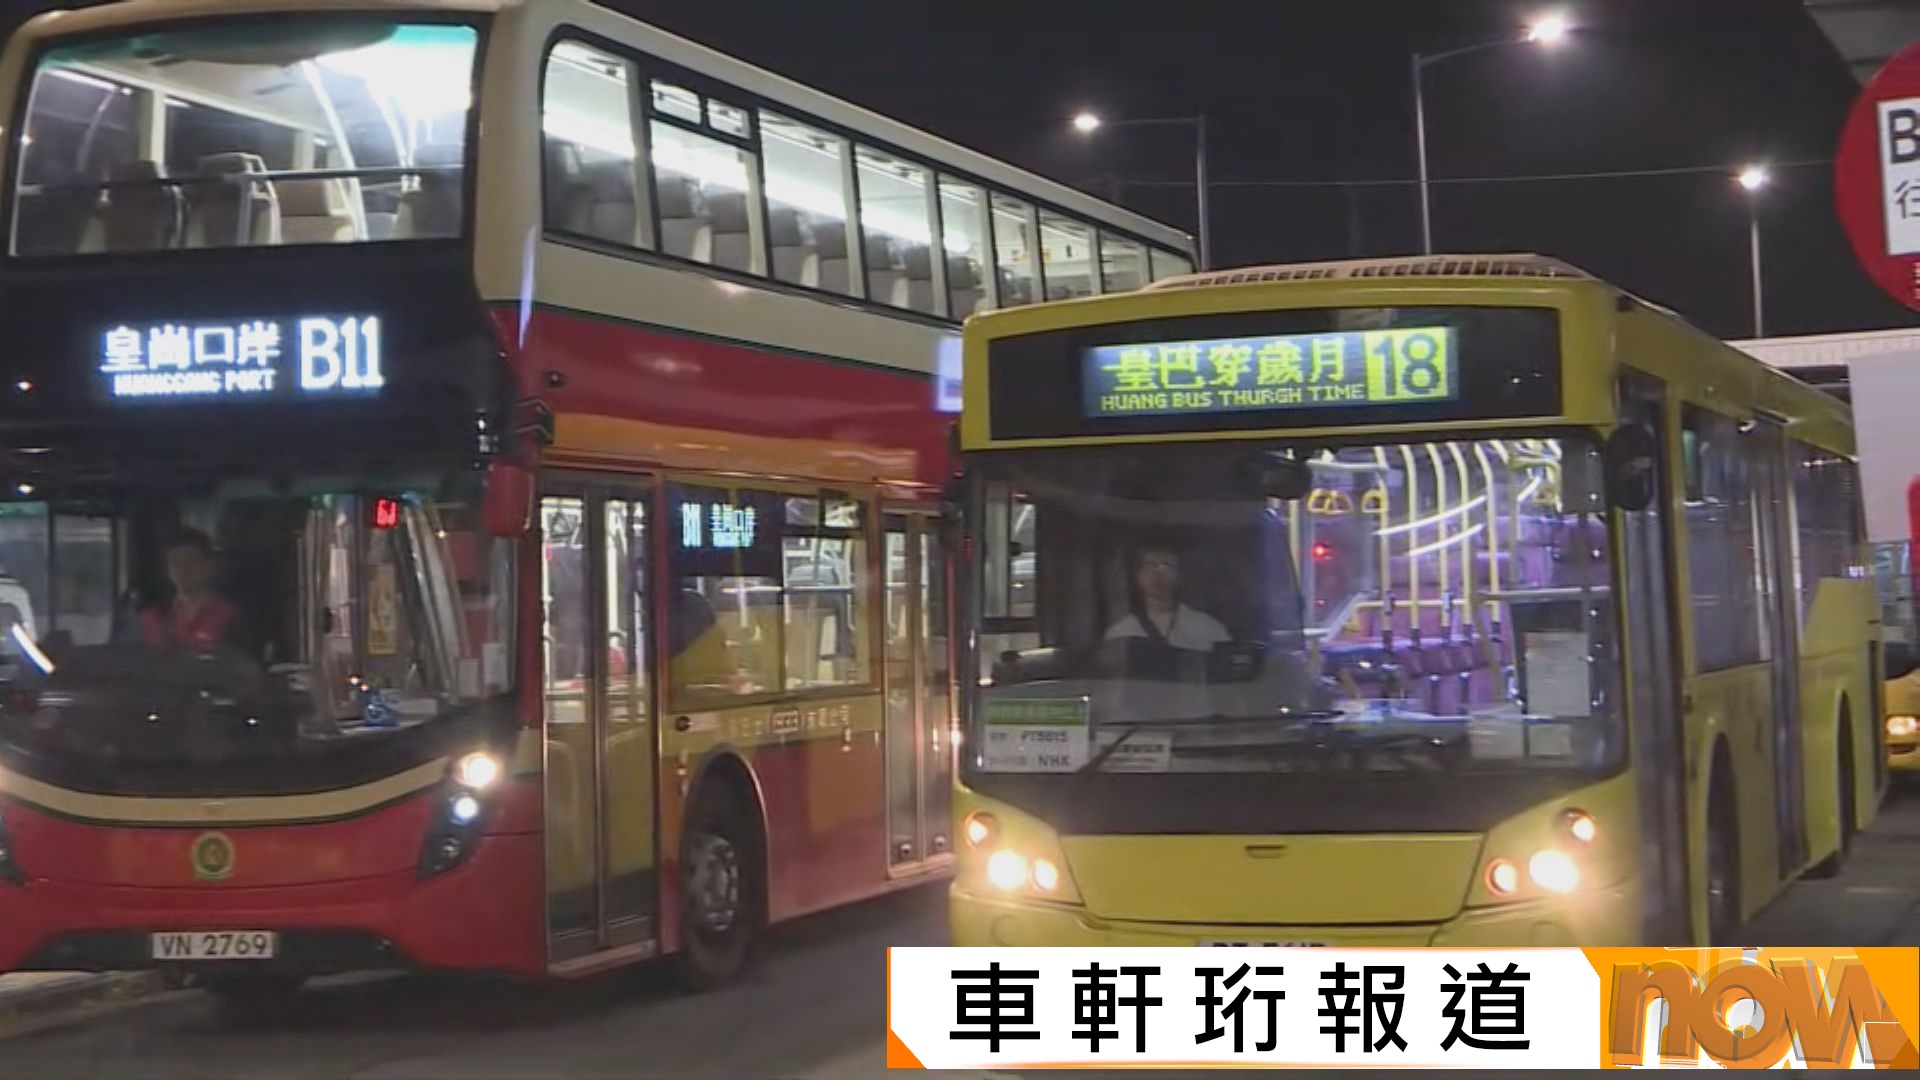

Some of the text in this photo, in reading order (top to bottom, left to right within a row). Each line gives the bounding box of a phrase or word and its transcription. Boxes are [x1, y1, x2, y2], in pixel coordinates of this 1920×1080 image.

[299, 315, 385, 389] B11
[1102, 336, 1346, 391] 皇巴穿歲月
[1372, 334, 1442, 396] 18
[225, 368, 277, 391] PORT
[1101, 383, 1366, 411] HUANG BUS THURGH TIME
[160, 934, 267, 956] VN 2769
